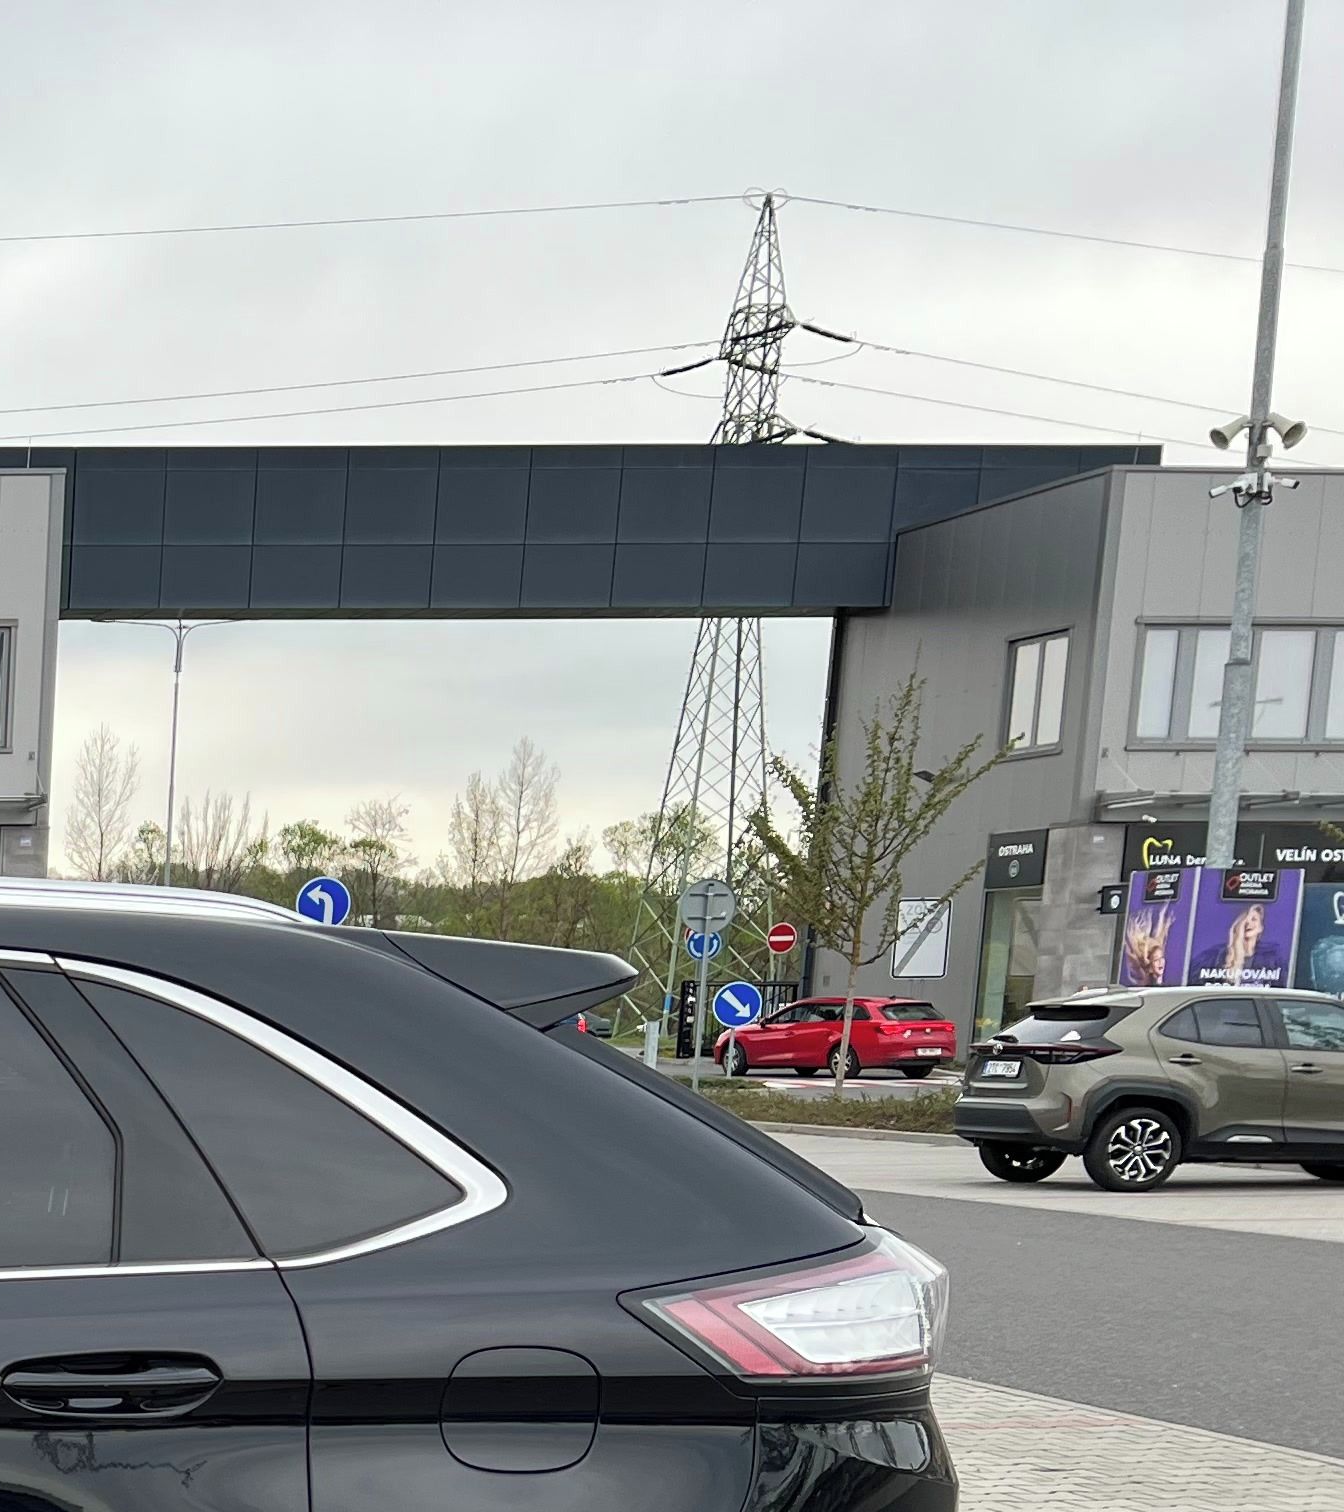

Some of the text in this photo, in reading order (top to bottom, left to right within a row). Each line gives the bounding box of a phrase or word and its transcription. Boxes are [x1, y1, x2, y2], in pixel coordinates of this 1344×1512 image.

[998, 843, 1034, 857] OSTRAHA
[1276, 845, 1317, 862] VELÍN
[1149, 854, 1181, 866] LUNA
[1239, 872, 1275, 883] OUTLET
